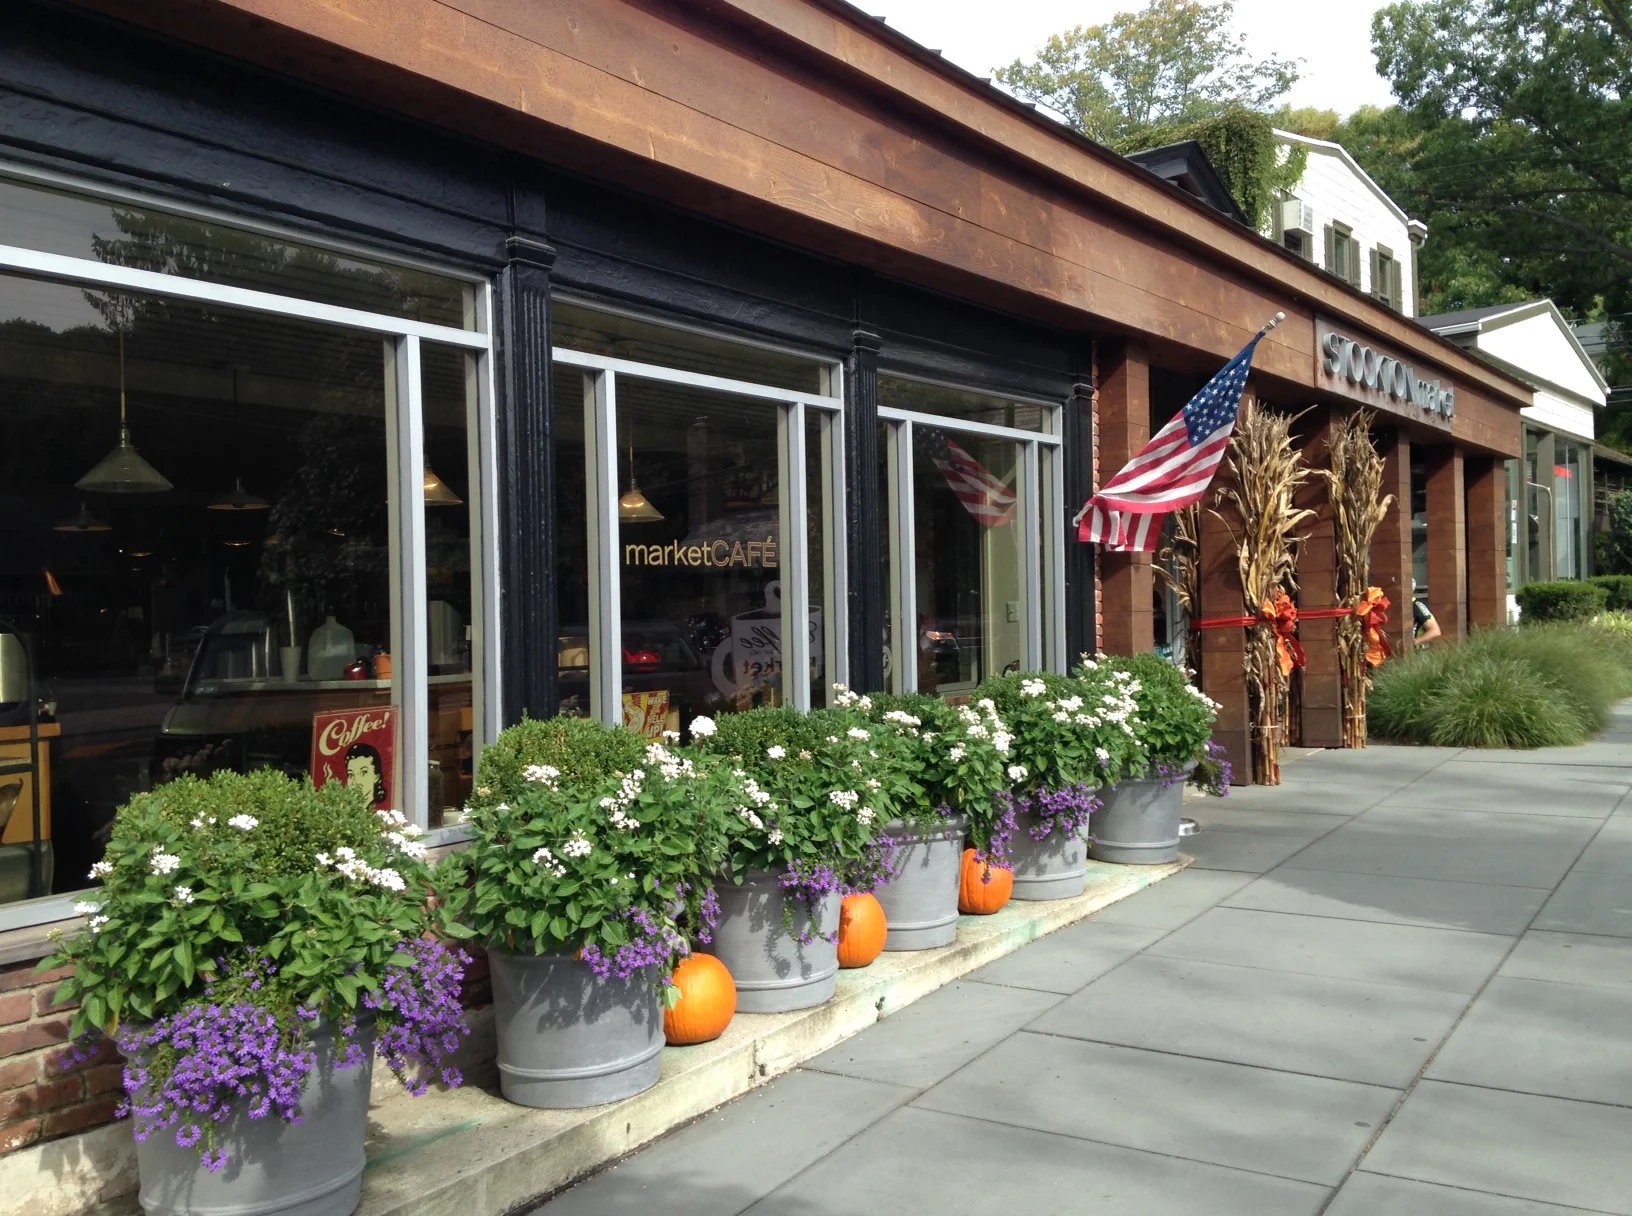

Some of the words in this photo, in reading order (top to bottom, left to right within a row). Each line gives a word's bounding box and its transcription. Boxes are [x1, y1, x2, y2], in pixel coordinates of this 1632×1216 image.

[625, 536, 777, 567] marketCAFÉ
[648, 696, 667, 705] WAKE
[319, 712, 390, 756] Coffee!
